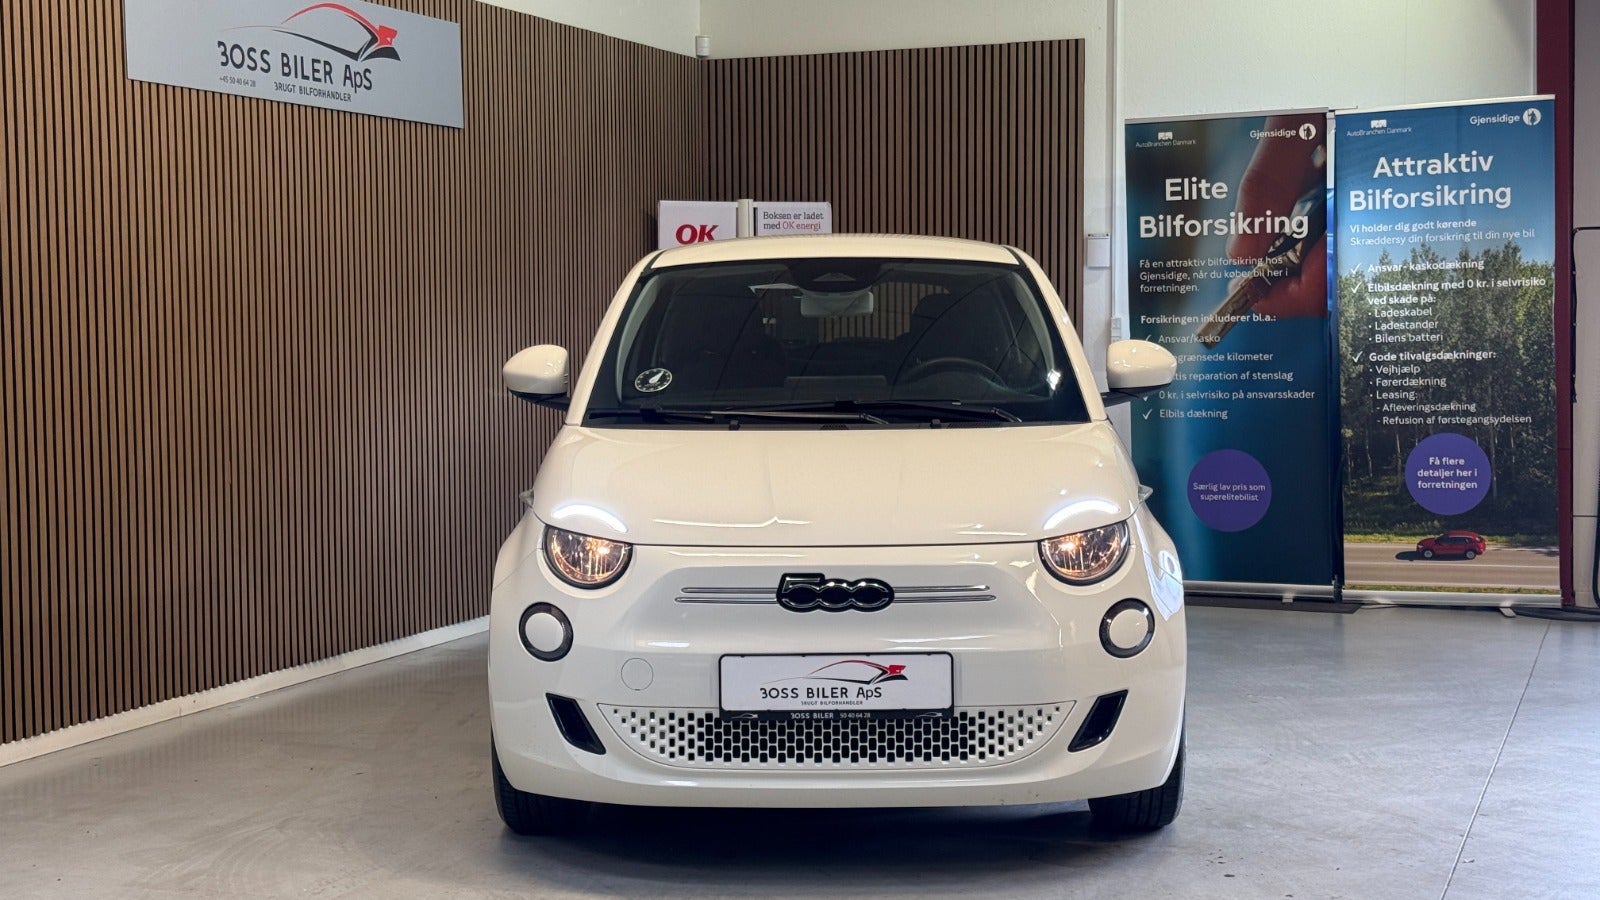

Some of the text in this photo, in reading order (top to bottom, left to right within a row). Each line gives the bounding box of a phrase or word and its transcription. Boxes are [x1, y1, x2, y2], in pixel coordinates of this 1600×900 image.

[281, 53, 333, 84] BILER
[343, 64, 372, 93] ApS
[299, 86, 352, 102] BILFORHANDLER
[1470, 114, 1520, 125] Gjensidige
[1250, 129, 1296, 139] Gjensidige
[1387, 126, 1412, 134] Danmark
[1373, 150, 1494, 178] Attraktiv
[1165, 177, 1228, 201] Elite
[1349, 182, 1511, 211] Bilforsikring
[763, 212, 791, 220] Boksen
[803, 212, 824, 220] ladet
[763, 221, 780, 229] med
[796, 222, 821, 231] energi
[1140, 210, 1309, 239] Bilforsikring
[1350, 219, 1477, 233] Vi holder dig godt kørende
[676, 224, 719, 245] OK
[1350, 229, 1535, 246] Skræddersy din forsikring til din nye bil
[1140, 259, 1150, 268] Få
[1166, 258, 1206, 268] attraktiv
[1208, 257, 1263, 267] bilforsikring
[1266, 256, 1283, 264] hos
[1409, 261, 1484, 271] kaskodækning
[1140, 271, 1191, 281] Gjensidige,
[1210, 271, 1222, 279] du
[1224, 270, 1251, 279] køber
[1253, 269, 1264, 277] bil
[1267, 269, 1283, 277] her
[1285, 268, 1288, 276] i
[1140, 283, 1200, 294] forretningen.
[1368, 277, 1546, 293] Elbilsdækning med 0 kr. i selvrisiko
[1368, 294, 1436, 305] ved skade på:
[1375, 307, 1432, 318] Ladeskabel
[1141, 314, 1198, 324] Forsikringen
[1201, 314, 1250, 323] inkluderer
[1375, 321, 1438, 330] Ladestander
[1159, 334, 1220, 344] Ansvar/kasko
[1375, 333, 1443, 343] Bilens batteri
[1175, 352, 1273, 363] grænsede kilometer
[1369, 351, 1496, 363] Gode tilvalgsdækninger:
[1376, 365, 1420, 375] Vejhjælp
[1189, 371, 1238, 381] reparation
[1240, 371, 1250, 379] af
[1252, 371, 1293, 381] stenslag
[1376, 377, 1447, 387] Førerdækning
[1159, 391, 1165, 399] 0
[1167, 391, 1179, 400] kr.
[1186, 390, 1230, 399] selvrisiko
[1232, 390, 1244, 400] på
[1247, 390, 1315, 399] ansvarsskader
[1376, 391, 1418, 400] Leasing:
[1383, 402, 1476, 412] Afleveringsdækning
[1160, 409, 1228, 420] Elbils dækning
[1383, 415, 1531, 425] Refusion af førstegangsydelsen
[1429, 457, 1465, 465] Få flere
[1417, 469, 1454, 479] detaljer
[1193, 483, 1218, 491] Særlig
[1418, 481, 1477, 490] forretningen
[776, 573, 894, 613] 500
[807, 688, 848, 699] BILER
[857, 687, 882, 700] ApS
